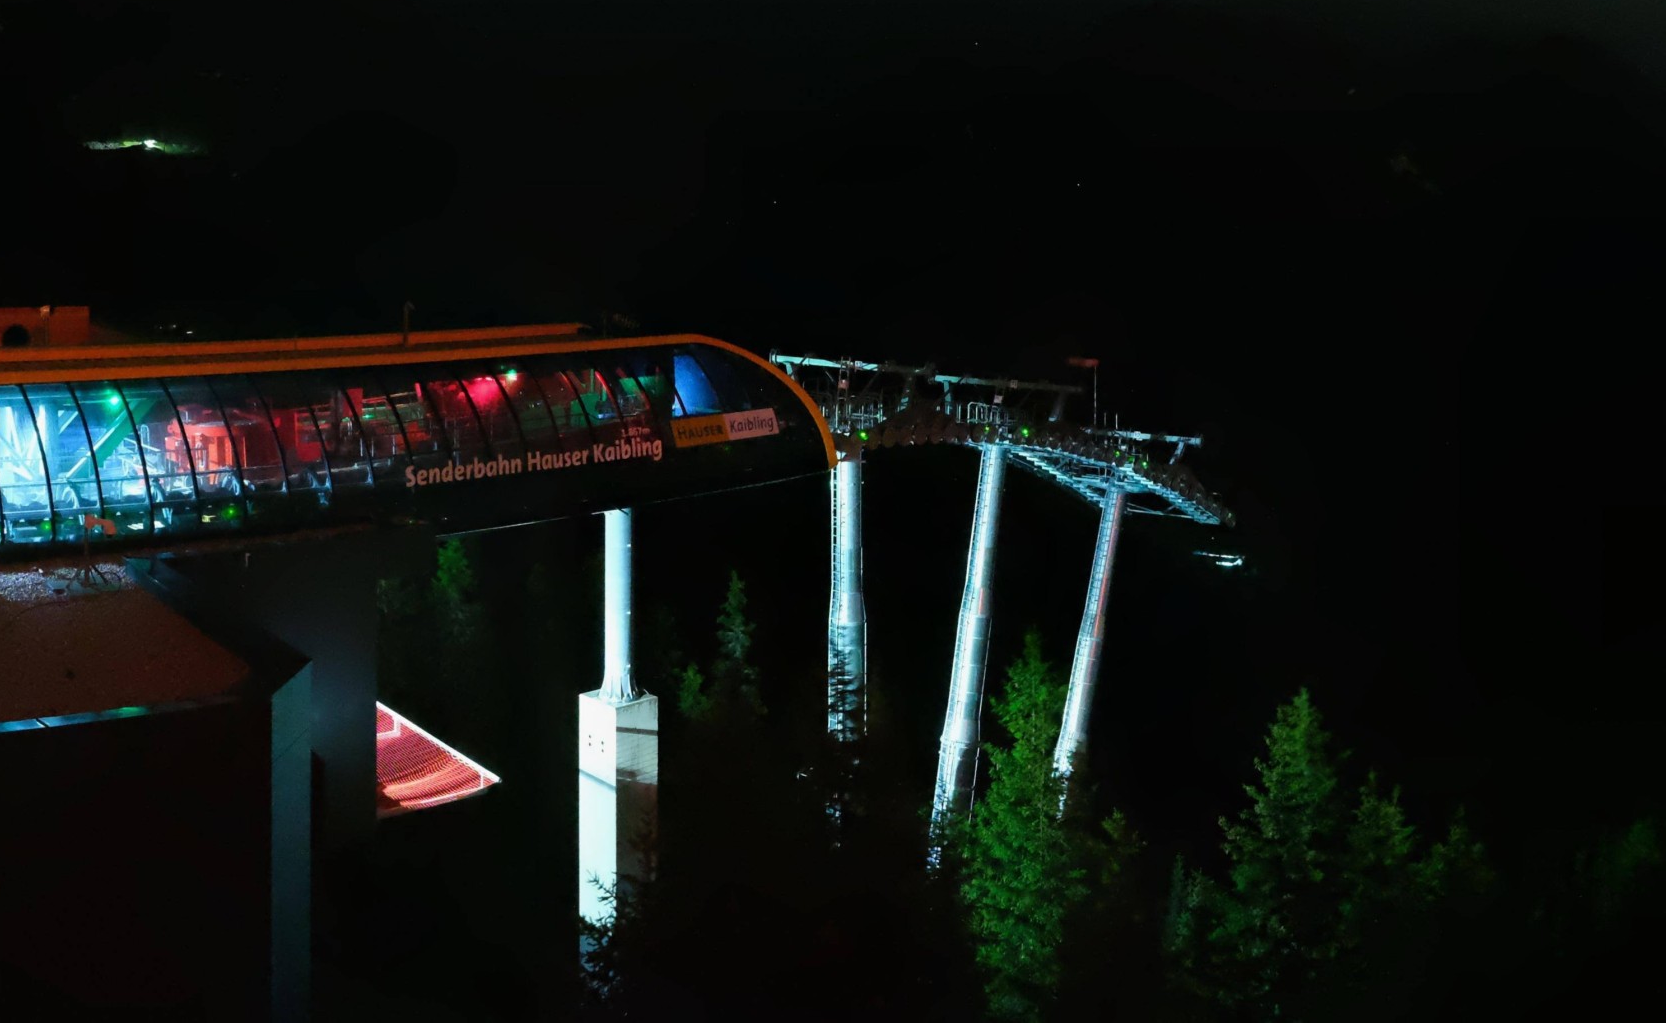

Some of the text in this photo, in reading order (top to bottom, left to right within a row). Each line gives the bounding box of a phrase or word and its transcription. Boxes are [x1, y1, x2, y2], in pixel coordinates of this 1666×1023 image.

[677, 415, 775, 440] HAUSER Kaibling
[405, 436, 663, 488] Senderbahn Hauser Kaibling
